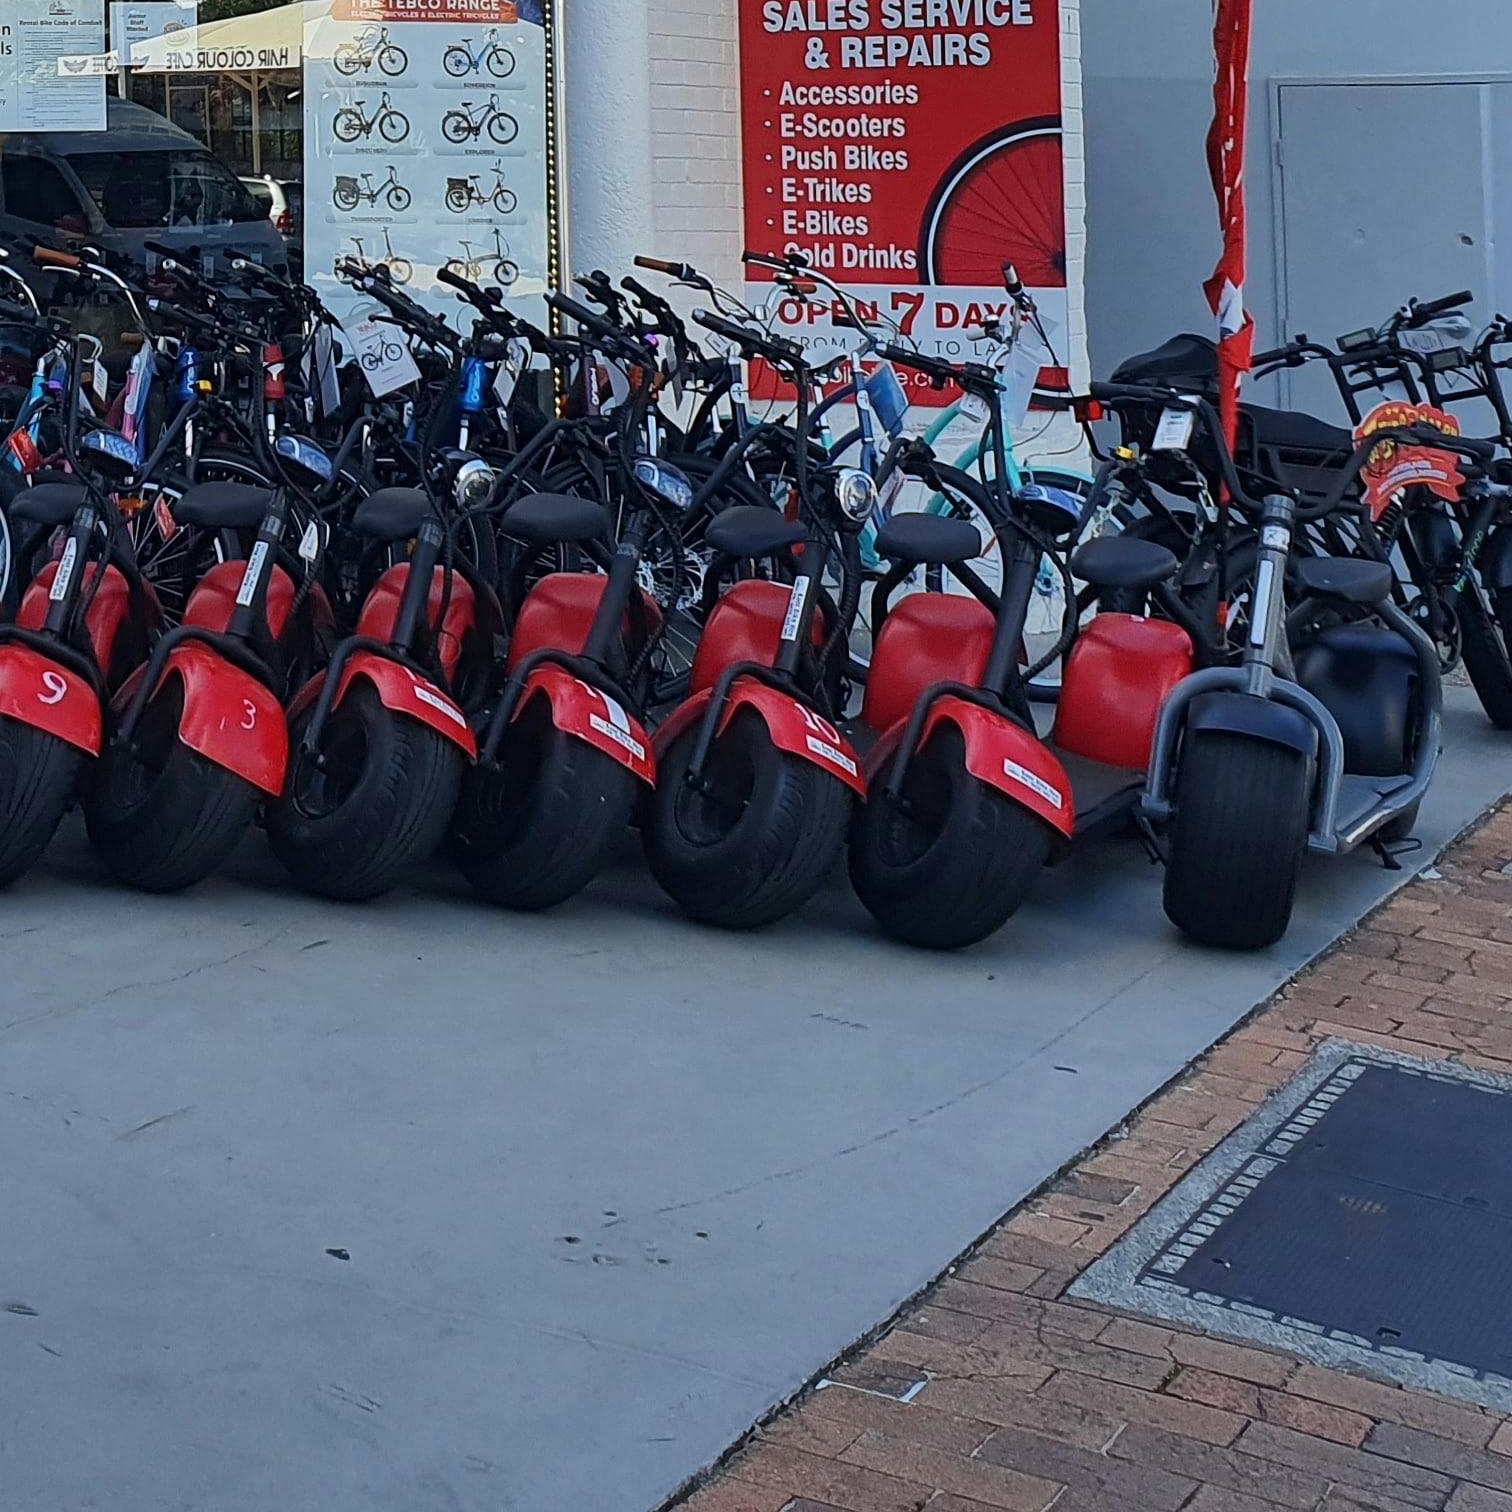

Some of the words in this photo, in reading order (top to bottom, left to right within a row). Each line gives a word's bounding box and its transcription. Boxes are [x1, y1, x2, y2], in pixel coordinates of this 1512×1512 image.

[804, 36, 830, 70] &
[840, 32, 992, 68] REPAIRS
[779, 80, 919, 106] Accessories
[779, 112, 906, 138] E-Scooters
[781, 145, 837, 171] Push
[844, 144, 909, 171] Bikes
[782, 177, 872, 204] E-Trikes
[782, 209, 869, 236] E-Bikes
[841, 243, 918, 270] Drinks
[777, 298, 878, 326] OPEN
[890, 291, 925, 336] 7
[936, 340, 961, 356] TO
[37, 670, 68, 705] 9
